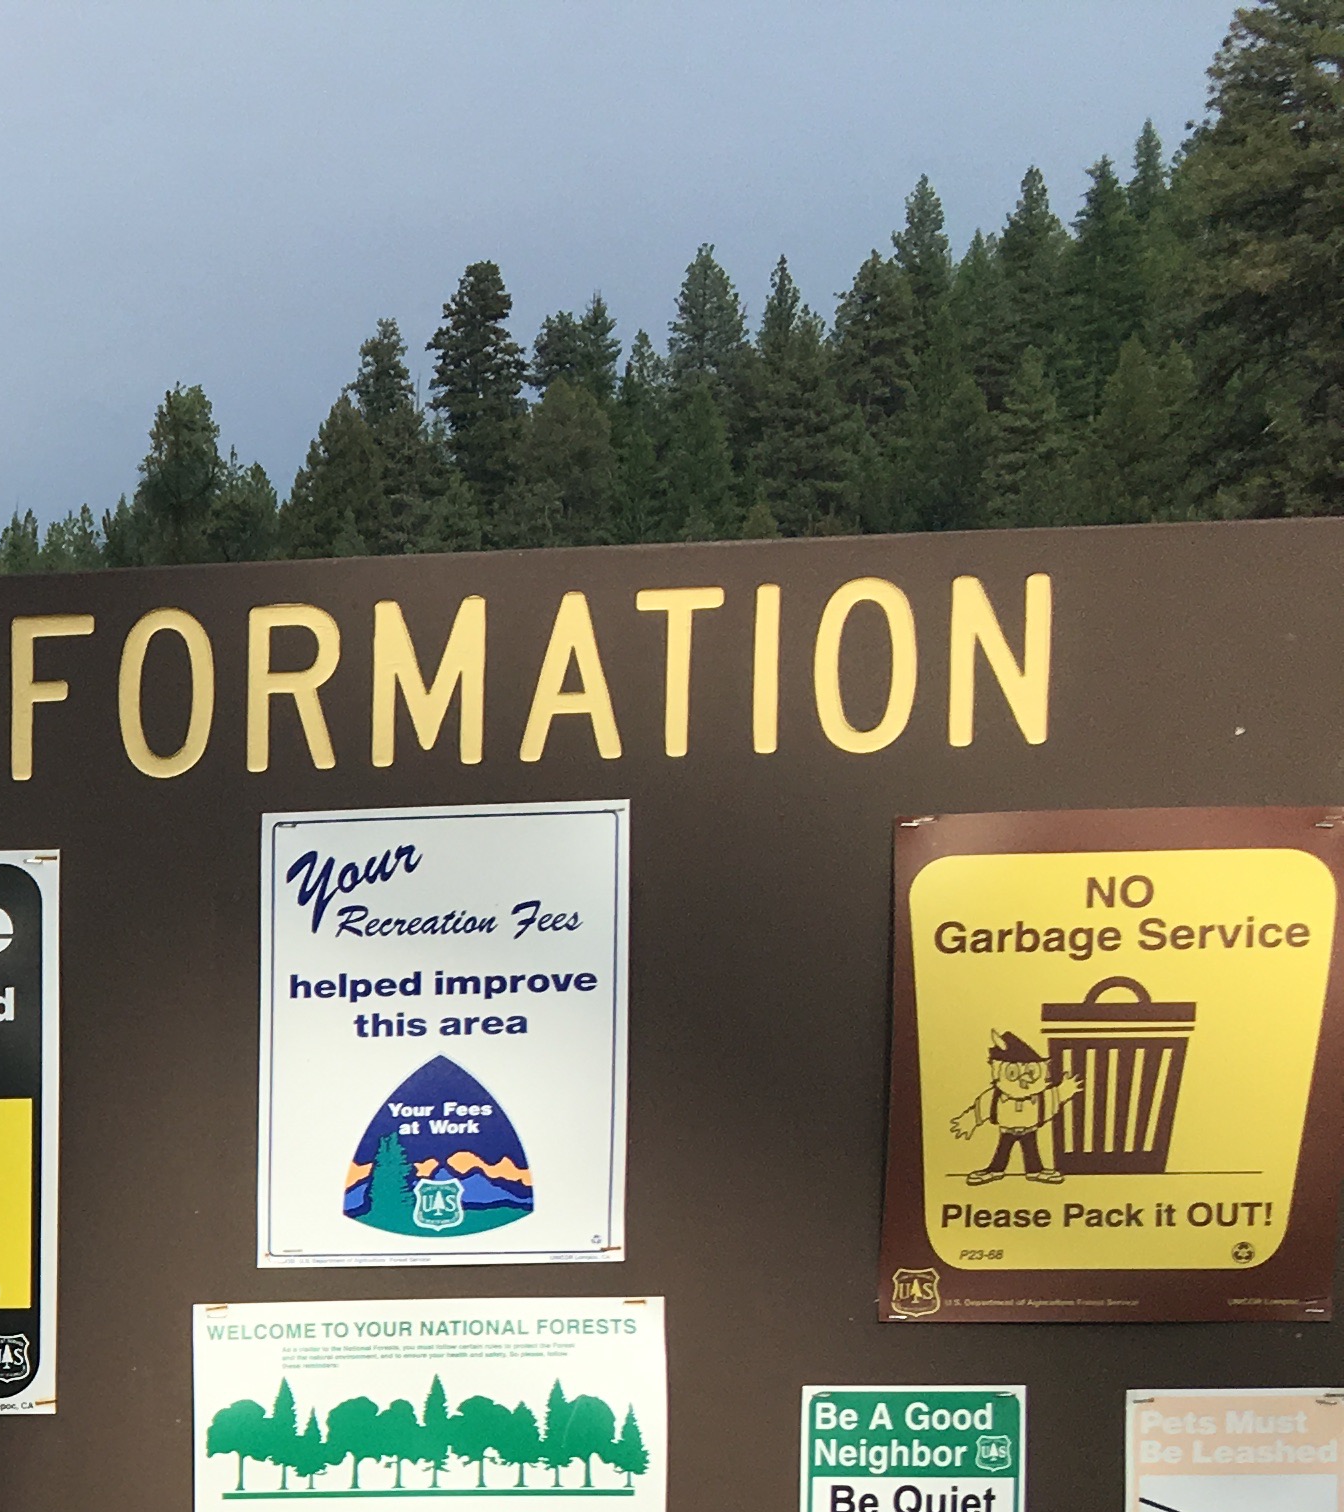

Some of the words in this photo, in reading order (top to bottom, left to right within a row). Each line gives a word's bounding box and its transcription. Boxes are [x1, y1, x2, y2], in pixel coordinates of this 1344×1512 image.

[286, 845, 422, 934] Your
[1085, 874, 1155, 909] NO
[335, 905, 498, 939] Recreation
[511, 900, 583, 939] Fees
[933, 920, 1122, 962] Garbage
[1137, 915, 1310, 951] Service
[289, 970, 422, 1004] helped
[434, 970, 598, 1000] improve
[353, 1011, 428, 1038] this
[438, 1015, 528, 1037] area
[387, 1101, 435, 1118] Your
[442, 1101, 494, 1118] Fees
[398, 1120, 420, 1136] at
[428, 1119, 480, 1135] Work
[941, 1203, 1052, 1229] Please
[1063, 1202, 1145, 1228] Pack
[1155, 1202, 1177, 1228] it
[1186, 1201, 1273, 1227] OUT!
[206, 1322, 317, 1341] WELCOME
[321, 1321, 349, 1339] TO
[353, 1320, 413, 1338] YOUR
[419, 1319, 530, 1337] NATIONAL
[536, 1318, 637, 1335] FORESTS
[813, 1401, 859, 1431] Be
[868, 1402, 894, 1431] A
[904, 1401, 993, 1431] Good
[1139, 1411, 1216, 1434] Pets
[1225, 1411, 1307, 1433] Must
[814, 1438, 968, 1475] Neighbor
[1140, 1441, 1181, 1464] Be
[1193, 1439, 1338, 1464] Leashed
